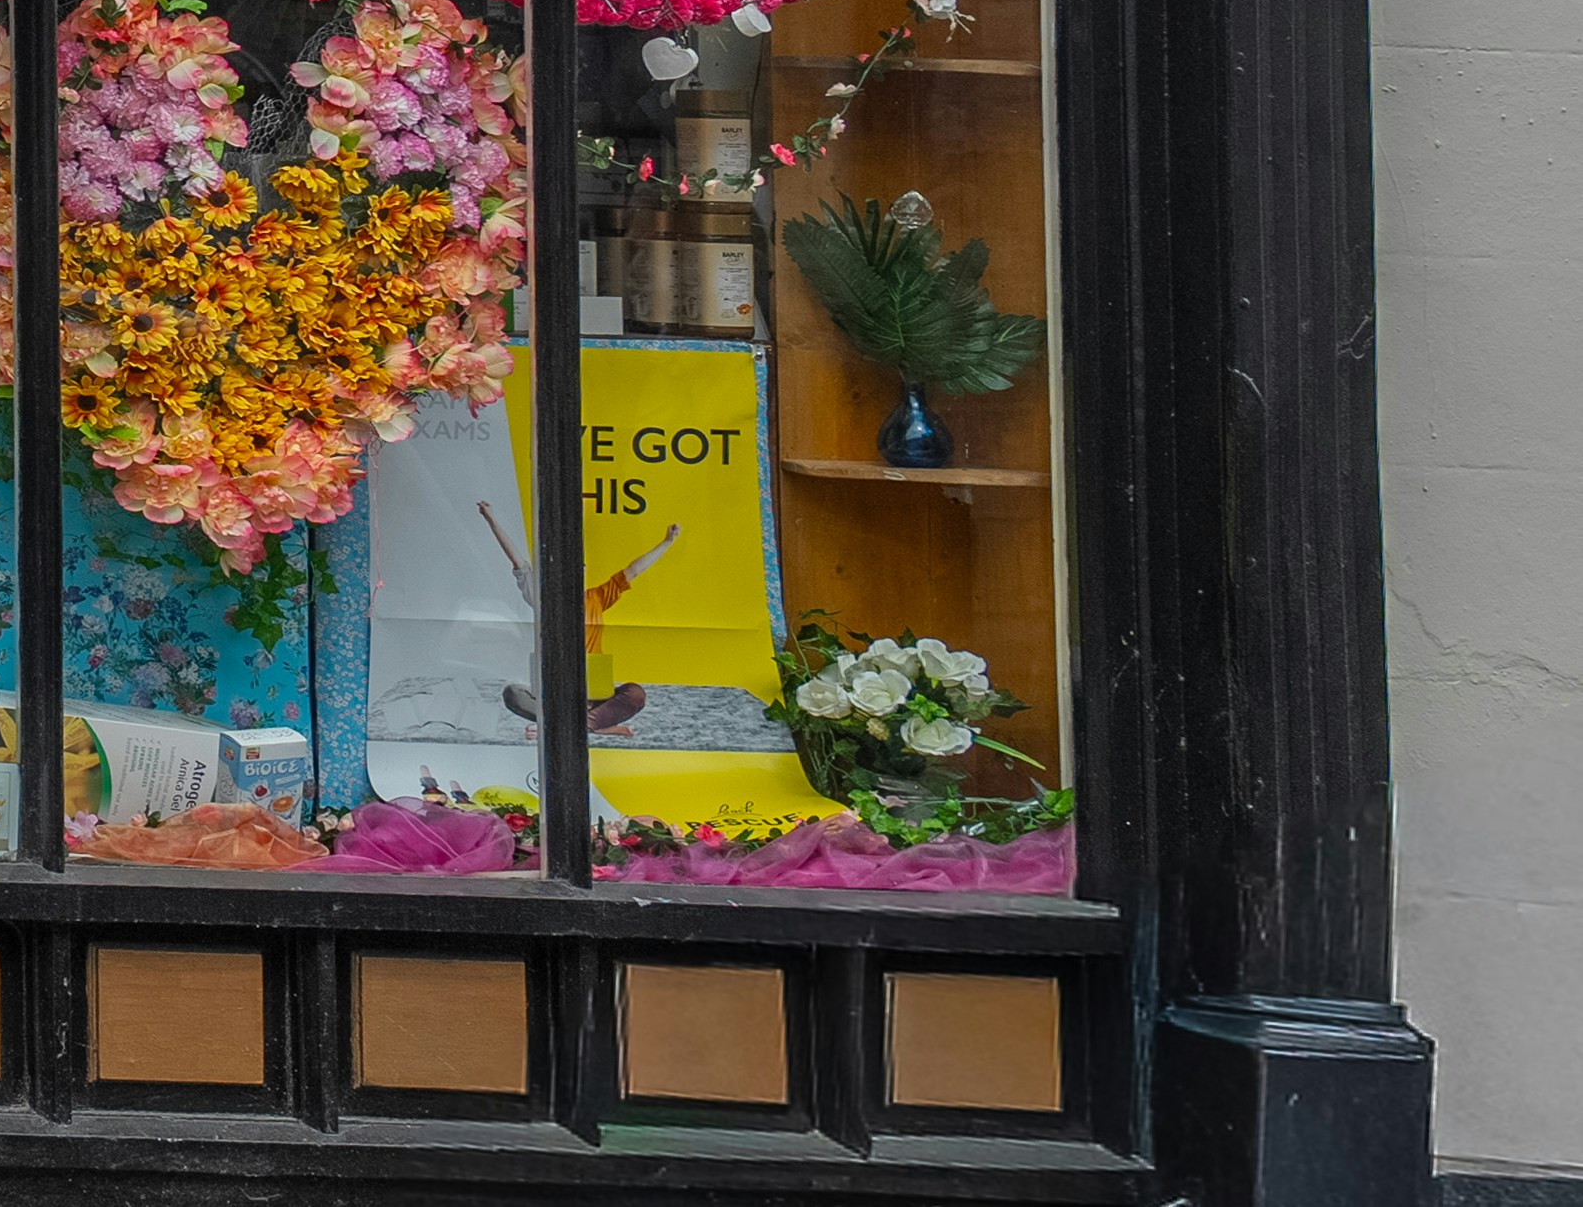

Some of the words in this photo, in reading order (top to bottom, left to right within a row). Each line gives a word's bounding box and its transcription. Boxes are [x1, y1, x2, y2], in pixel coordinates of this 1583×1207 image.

[412, 420, 491, 442] XAMS
[632, 426, 741, 465] GOT
[582, 477, 648, 516] HIS
[175, 757, 190, 791] Arnica
[184, 759, 208, 811] Atroge
[170, 794, 183, 812] Gel
[685, 812, 801, 833] RESCUE
